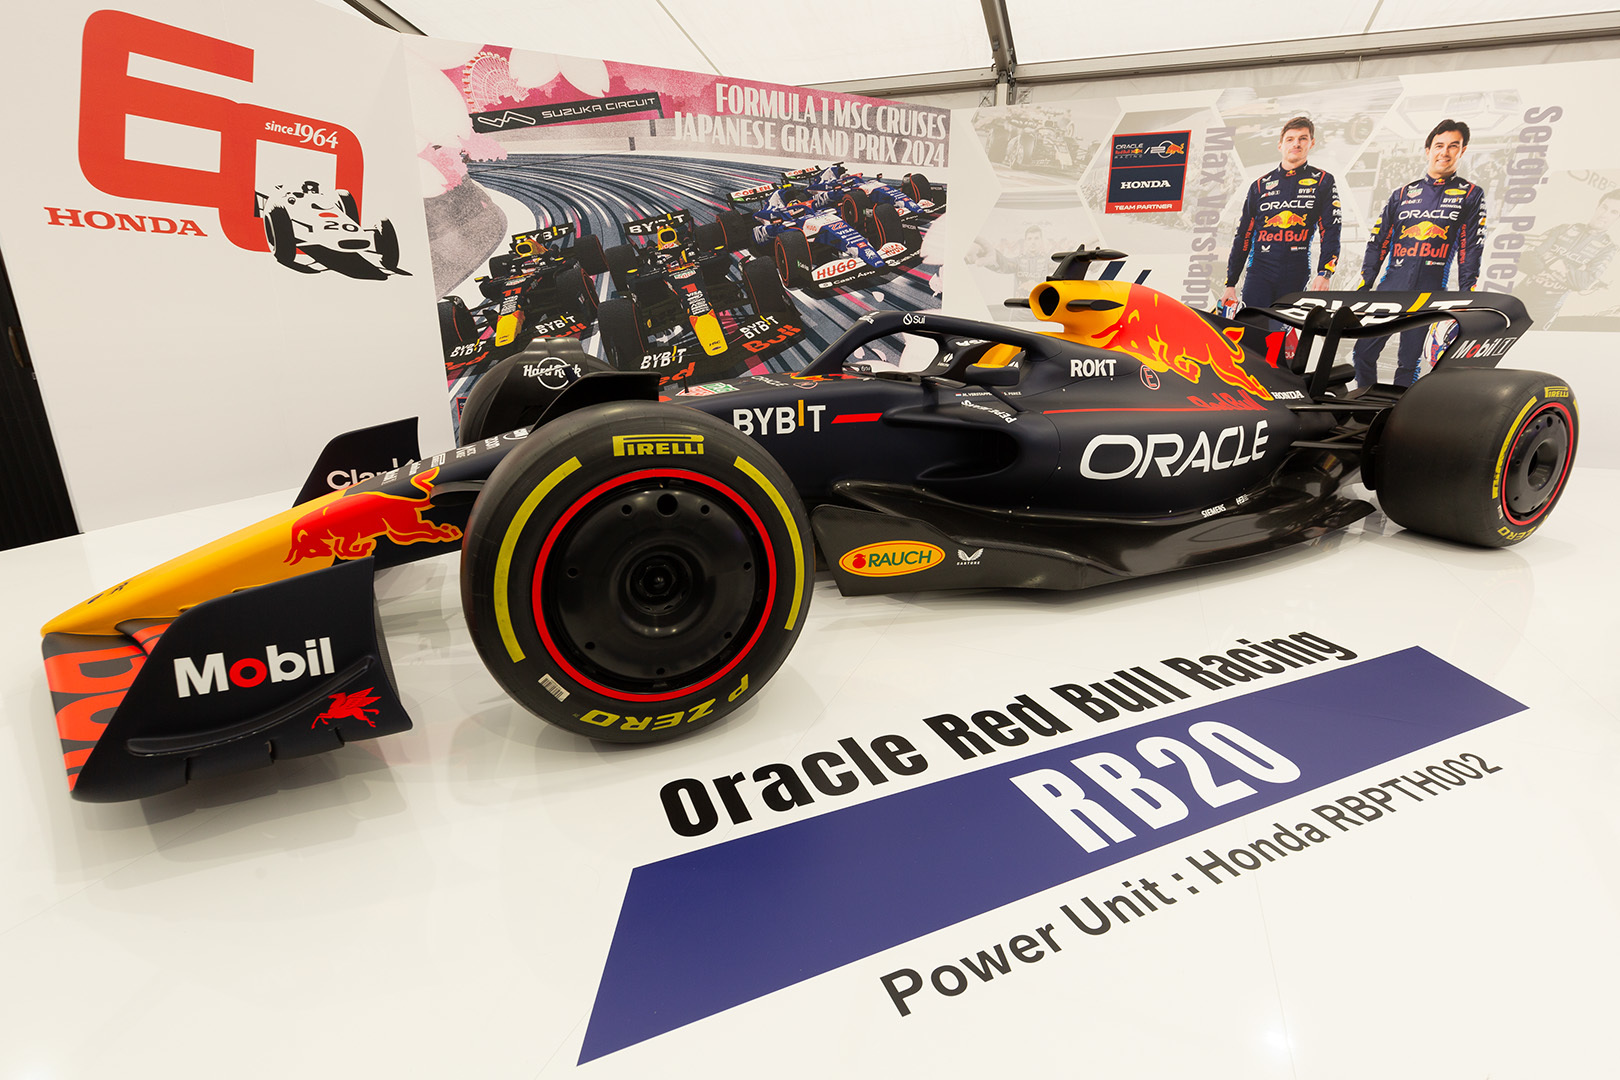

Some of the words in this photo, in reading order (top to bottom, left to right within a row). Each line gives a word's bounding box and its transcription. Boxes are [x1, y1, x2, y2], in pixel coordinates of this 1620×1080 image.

[541, 104, 602, 119] SUZUKA
[605, 97, 656, 110] CIRCUIT
[716, 83, 817, 124] FORMULA
[820, 97, 829, 128] 1
[834, 100, 872, 130] MSC
[876, 105, 947, 140] CRUISES
[672, 111, 776, 150] JAPANESE
[781, 124, 849, 157] GRAND
[854, 132, 898, 163] PRIX
[901, 139, 946, 168] 2024
[1200, 126, 1236, 185] Max
[1504, 105, 1563, 204] Sergio
[1120, 180, 1171, 190] HONDA
[1260, 200, 1315, 212] ORACLE
[1398, 209, 1461, 221] ORACLE
[44, 206, 208, 237] HONDA
[324, 221, 359, 233] 20
[829, 222, 848, 231] 22
[836, 228, 855, 236] VISA
[1257, 230, 1284, 243] Red
[1285, 229, 1309, 242] Bull
[1181, 193, 1227, 309] Verstapp
[1393, 242, 1419, 257] Red
[1419, 242, 1450, 259] Bull
[1483, 216, 1536, 294] Perez
[816, 259, 857, 279] HUGO
[502, 287, 522, 297] 11
[535, 312, 577, 335] BYBIT
[912, 315, 927, 325] Sui
[742, 324, 801, 354] Bull
[1264, 331, 1287, 369] 1
[1450, 337, 1502, 359] Mobil
[640, 346, 687, 370] BYBIT
[1070, 359, 1117, 378] ROKT
[523, 364, 553, 378] Hard
[1271, 390, 1305, 400] HONDA
[1544, 386, 1570, 399] PIRELLI
[733, 400, 827, 436] BYBIT
[612, 434, 706, 457] PIRELLI
[1079, 420, 1270, 480] ORACLE
[1201, 503, 1227, 518] SIEMENS
[868, 550, 932, 568] RAUCH
[173, 637, 335, 698] Mobil
[728, 673, 749, 703] P
[579, 698, 717, 731] ZERO
[660, 734, 929, 837] Oracle
[922, 693, 1072, 761] Red
[1049, 666, 1192, 723] Bull
[1159, 631, 1358, 691] Racing
[1010, 721, 1301, 854] RB20
[879, 923, 1062, 1017] Power
[1059, 878, 1177, 936] Unit
[1185, 822, 1331, 885] Honda
[1311, 751, 1502, 832] RBPTH002
